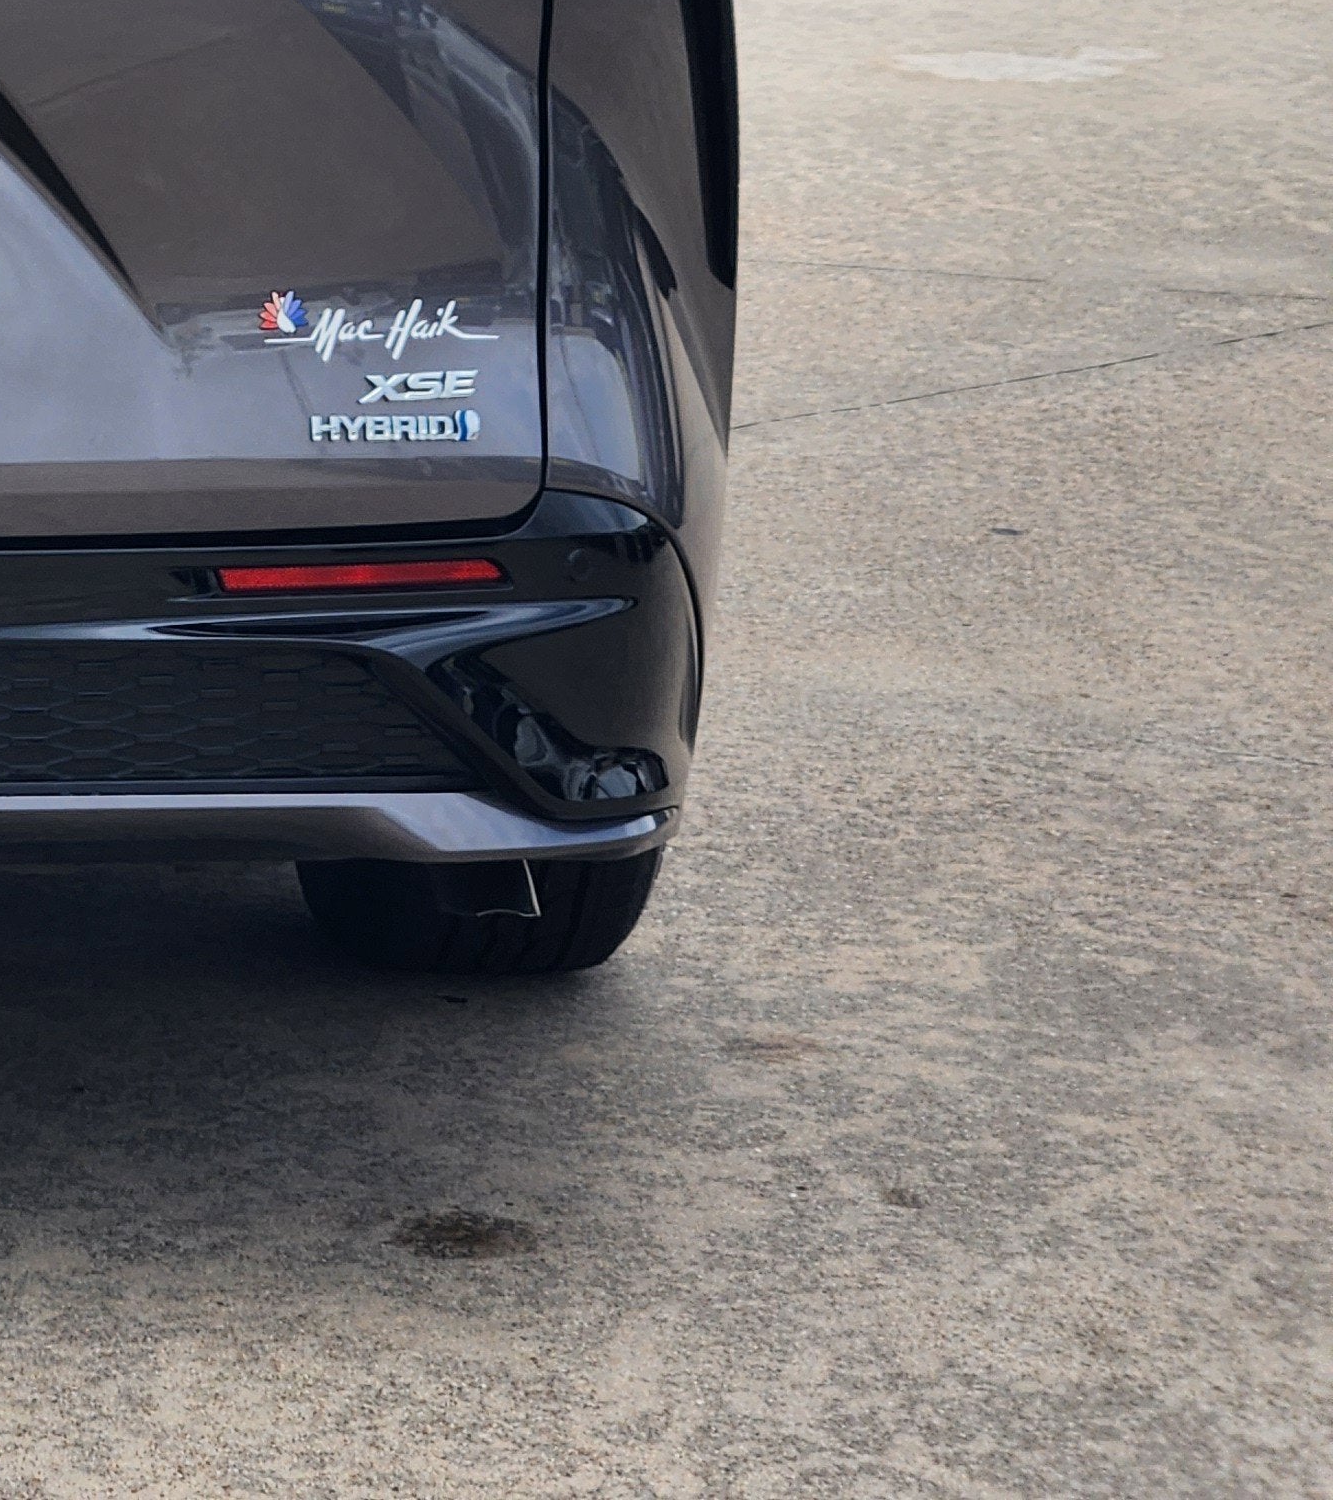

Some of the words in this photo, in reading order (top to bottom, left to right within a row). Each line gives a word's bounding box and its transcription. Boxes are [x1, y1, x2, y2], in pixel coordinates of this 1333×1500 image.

[309, 307, 384, 362] Mac
[384, 298, 465, 361] Haik
[356, 368, 480, 405] XSE
[309, 414, 459, 442] HYBRID
